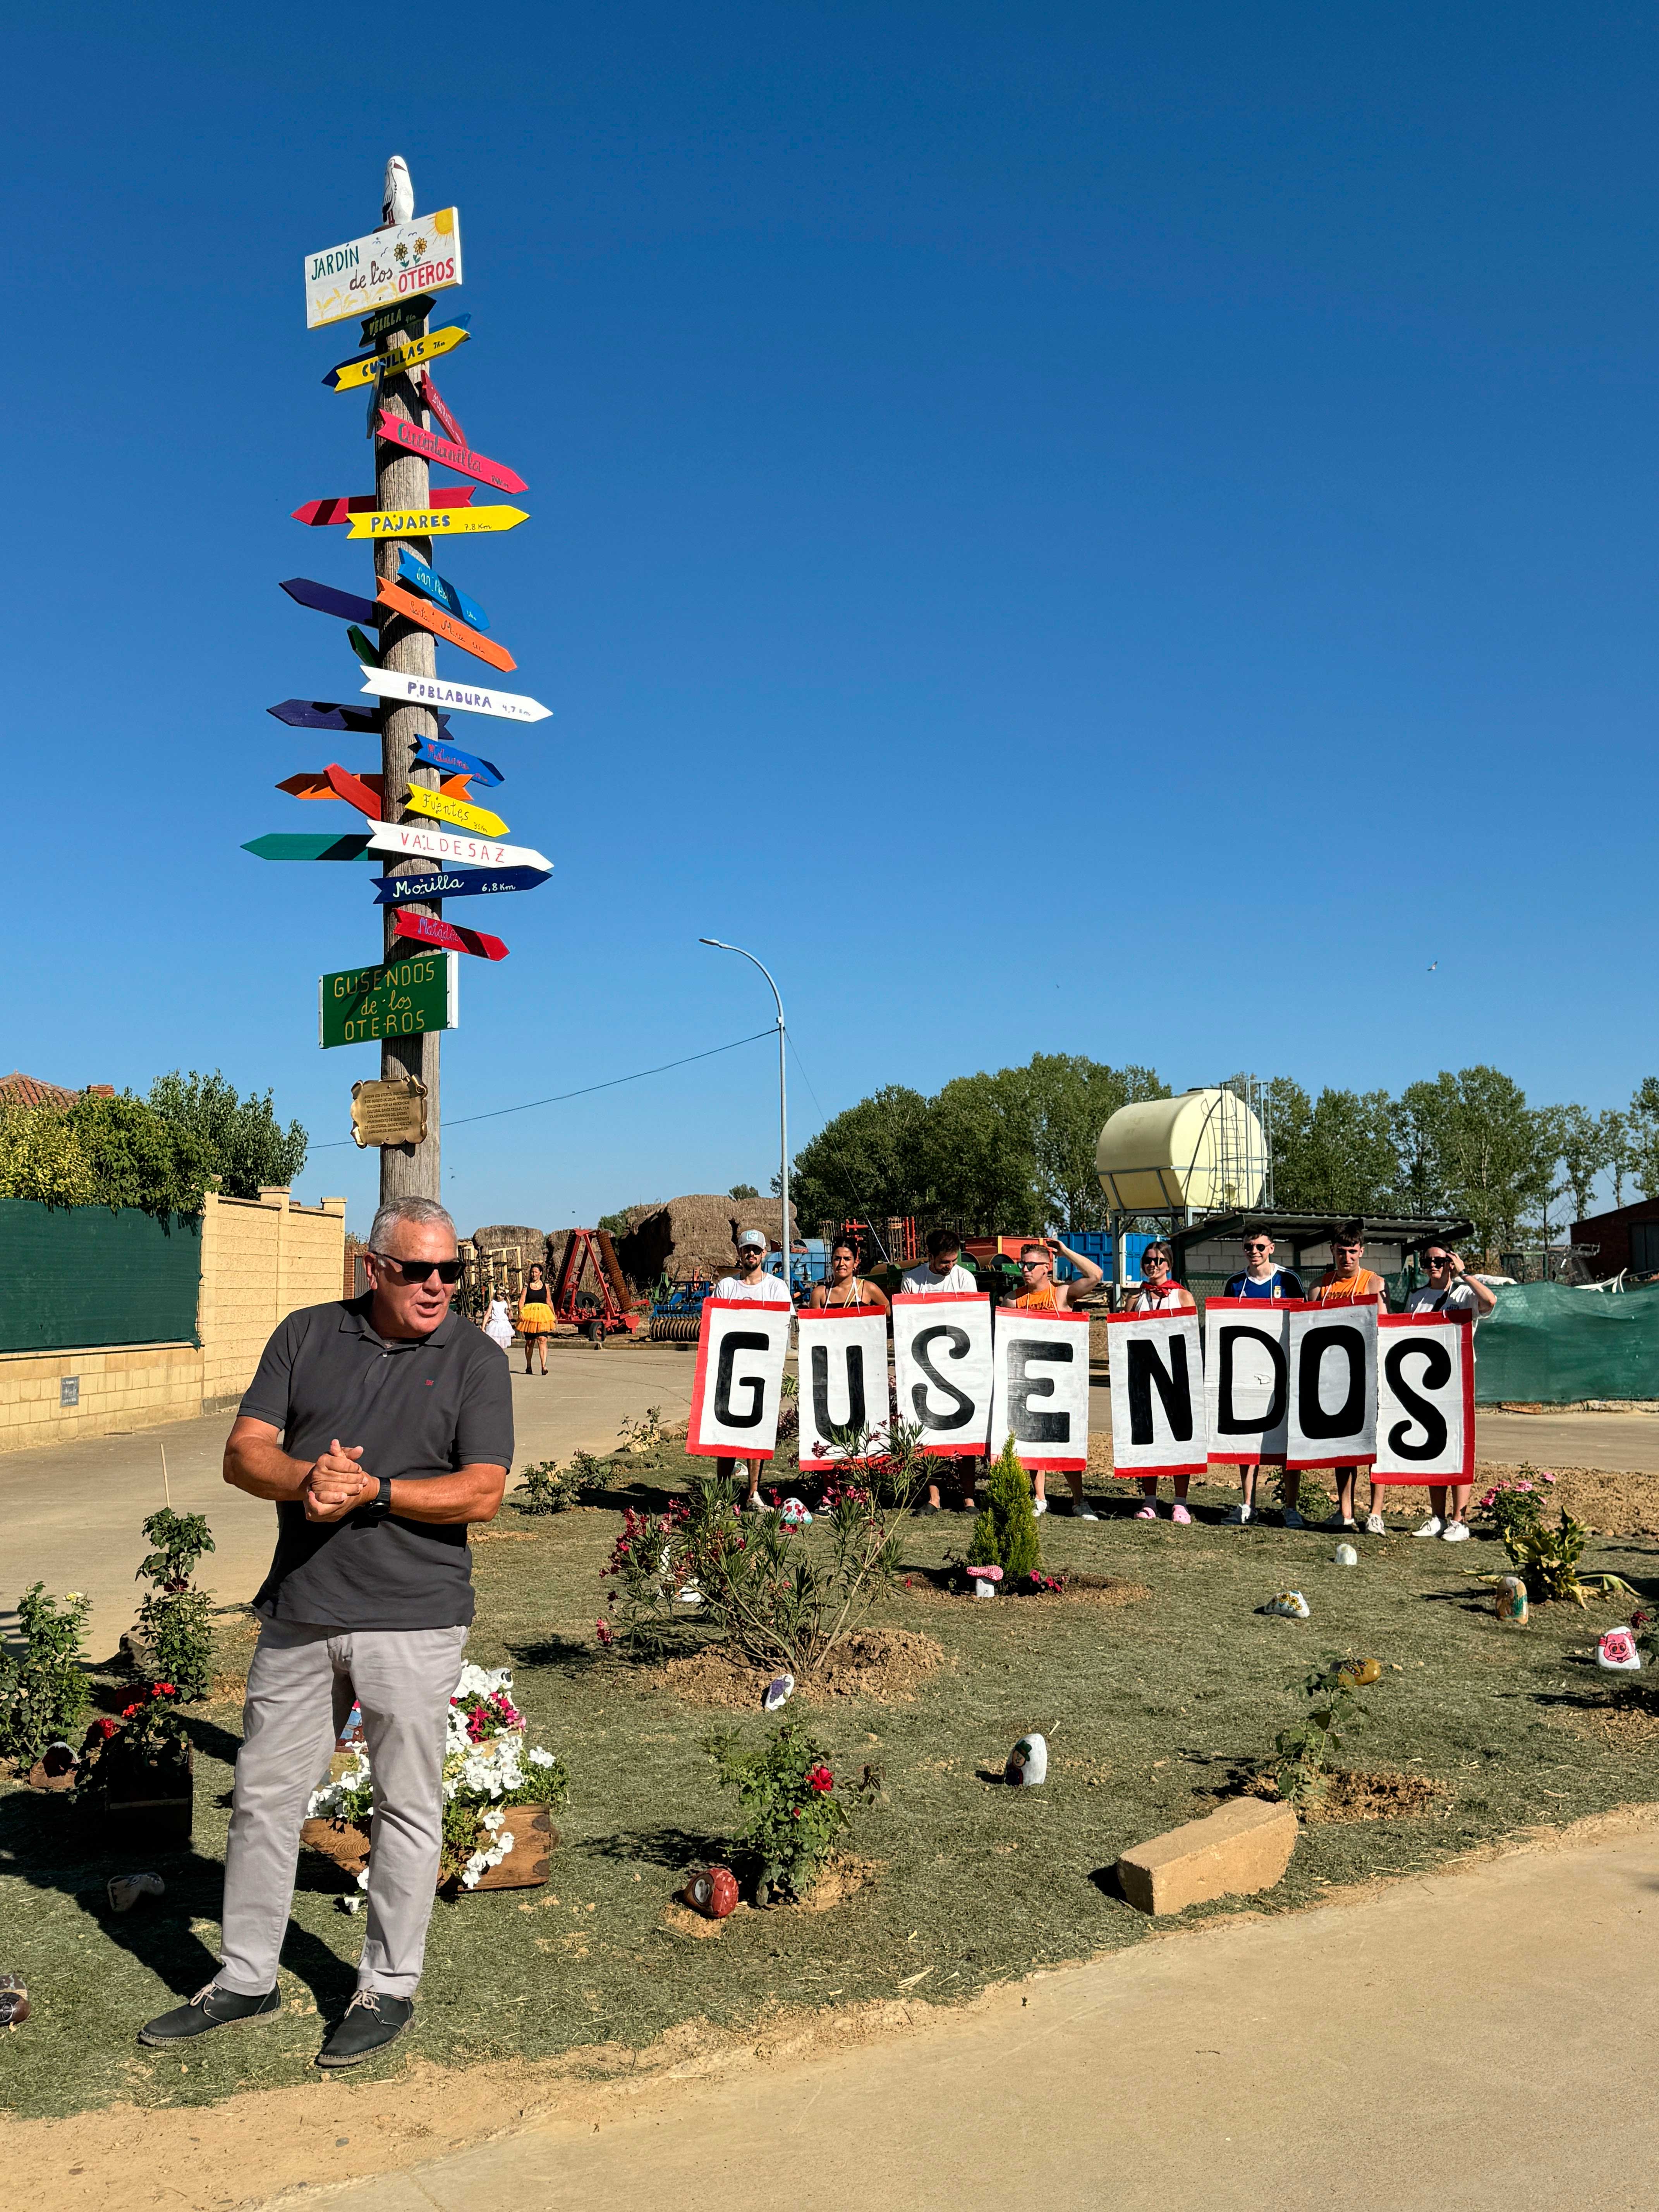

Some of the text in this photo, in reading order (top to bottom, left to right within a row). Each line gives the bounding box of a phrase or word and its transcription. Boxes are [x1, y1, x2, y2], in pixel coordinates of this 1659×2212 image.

[312, 244, 359, 280] JARDÍN
[349, 257, 454, 292] de los OTEROS
[369, 309, 401, 335] VELILLA
[371, 515, 450, 532] PAJARES
[408, 682, 492, 708] POBLADURA
[422, 793, 469, 821] Fuentes
[401, 832, 505, 863] VALDESAZ
[393, 875, 464, 898] Morilla
[335, 962, 434, 998] GUSENDOS
[361, 989, 412, 1015] de los
[345, 1010, 424, 1040] OTEROS
